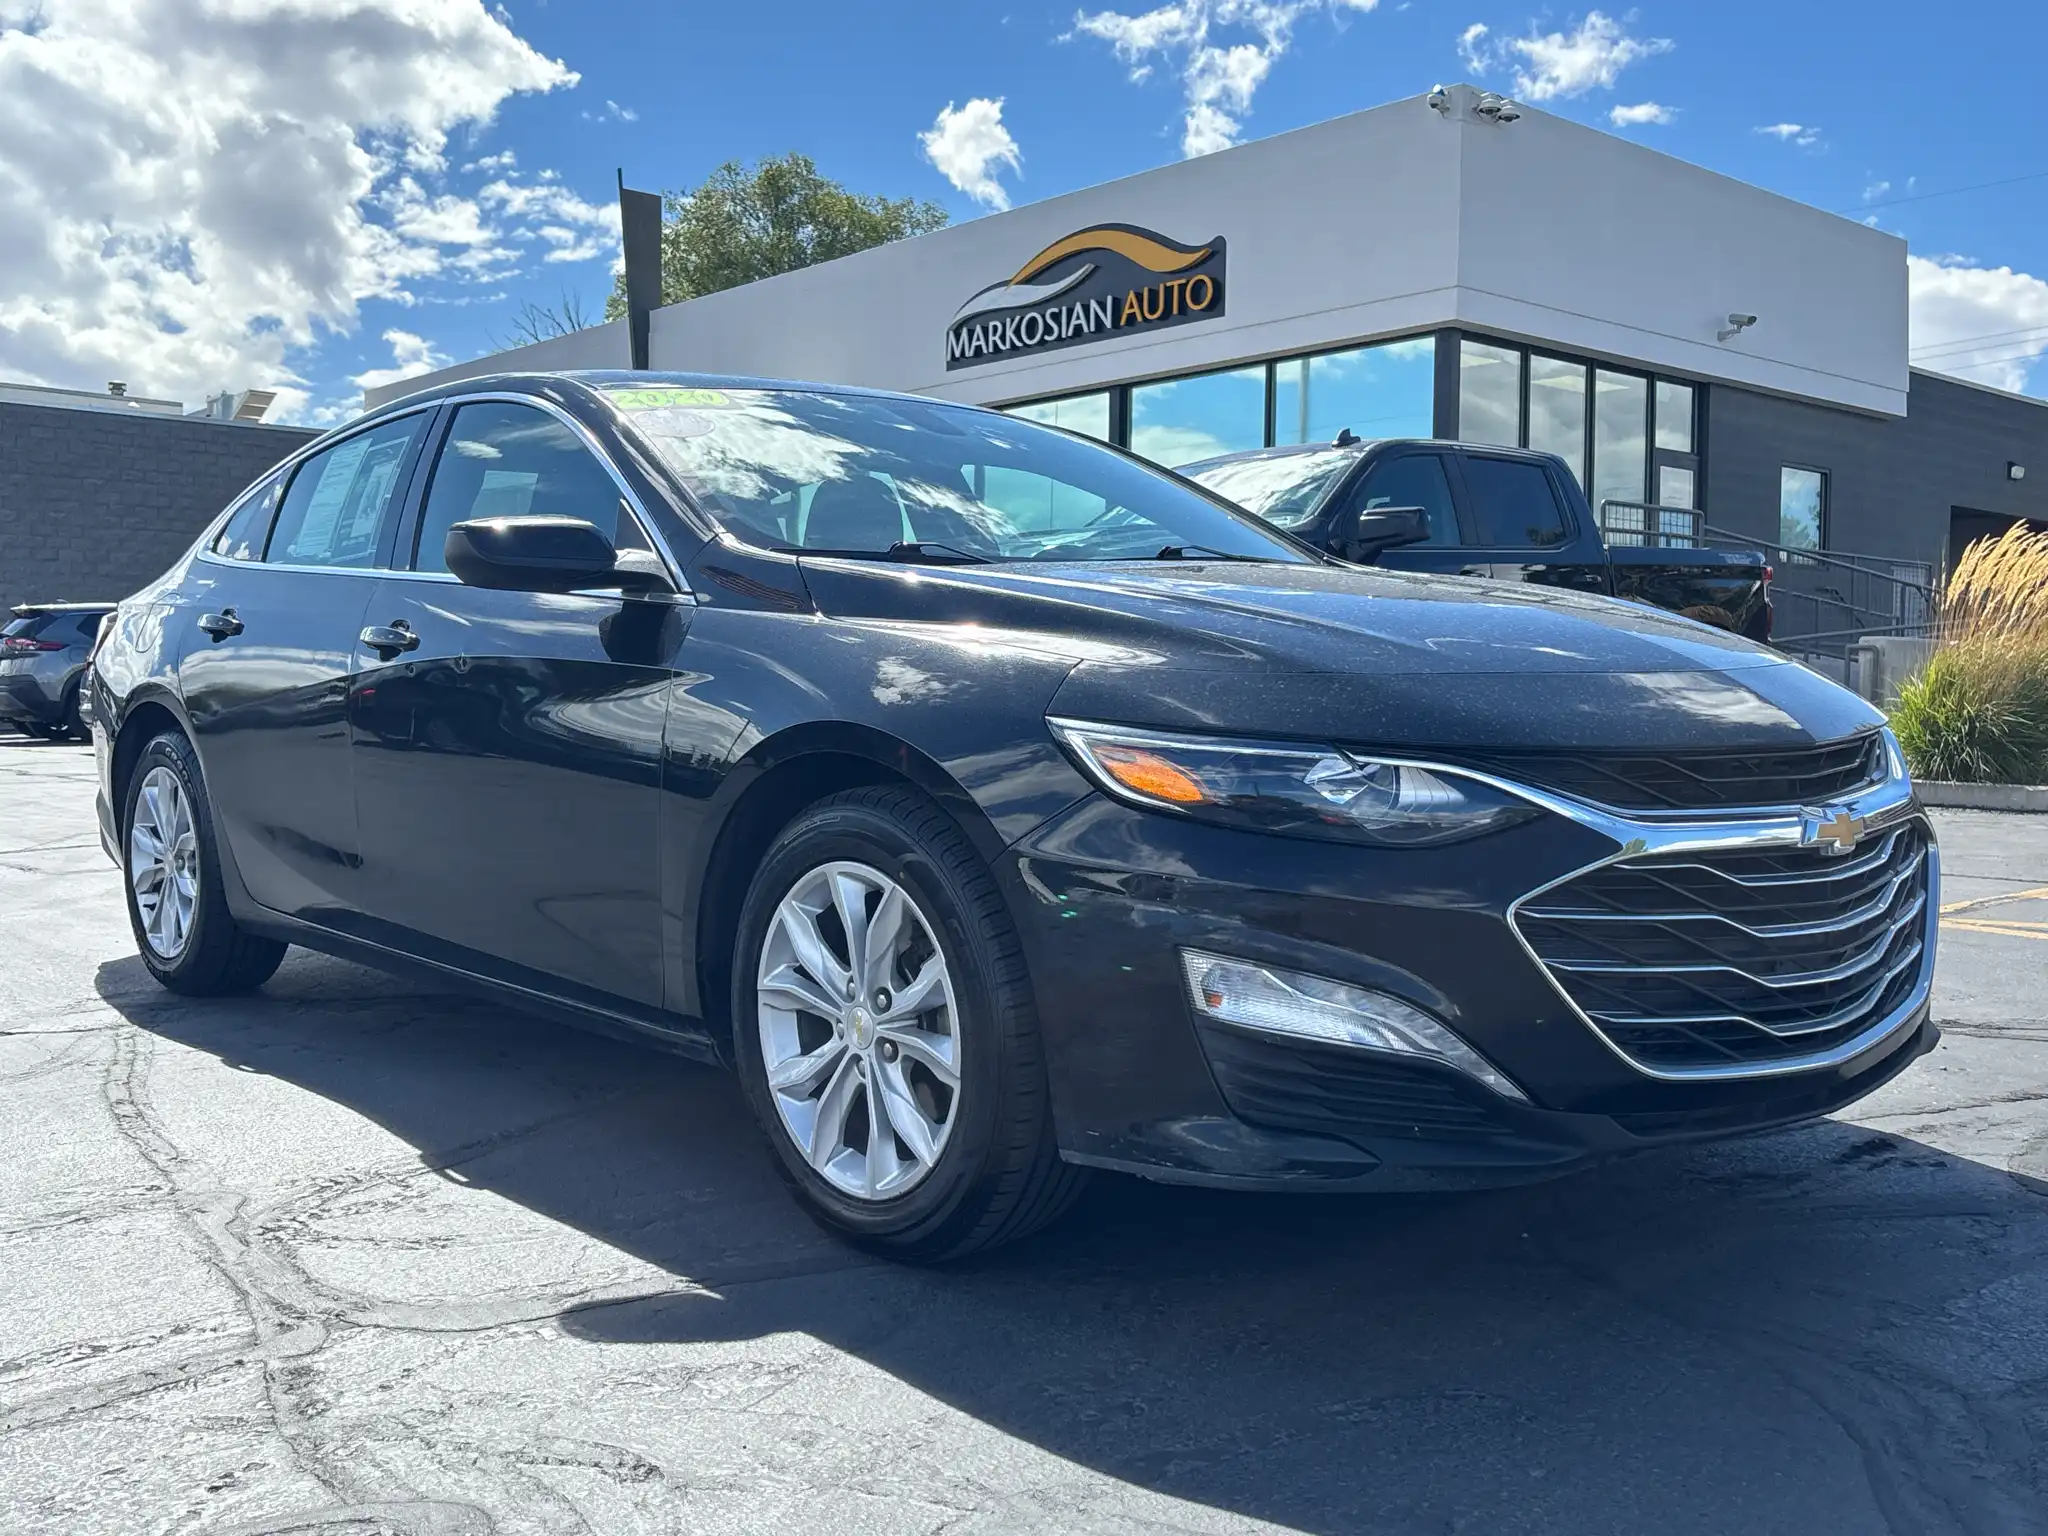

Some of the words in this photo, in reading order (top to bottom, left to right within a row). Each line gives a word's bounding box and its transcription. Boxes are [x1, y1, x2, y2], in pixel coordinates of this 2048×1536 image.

[947, 294, 1113, 362] MARKOSIAN
[1120, 274, 1213, 326] AUTO
[611, 389, 730, 409] 2020
